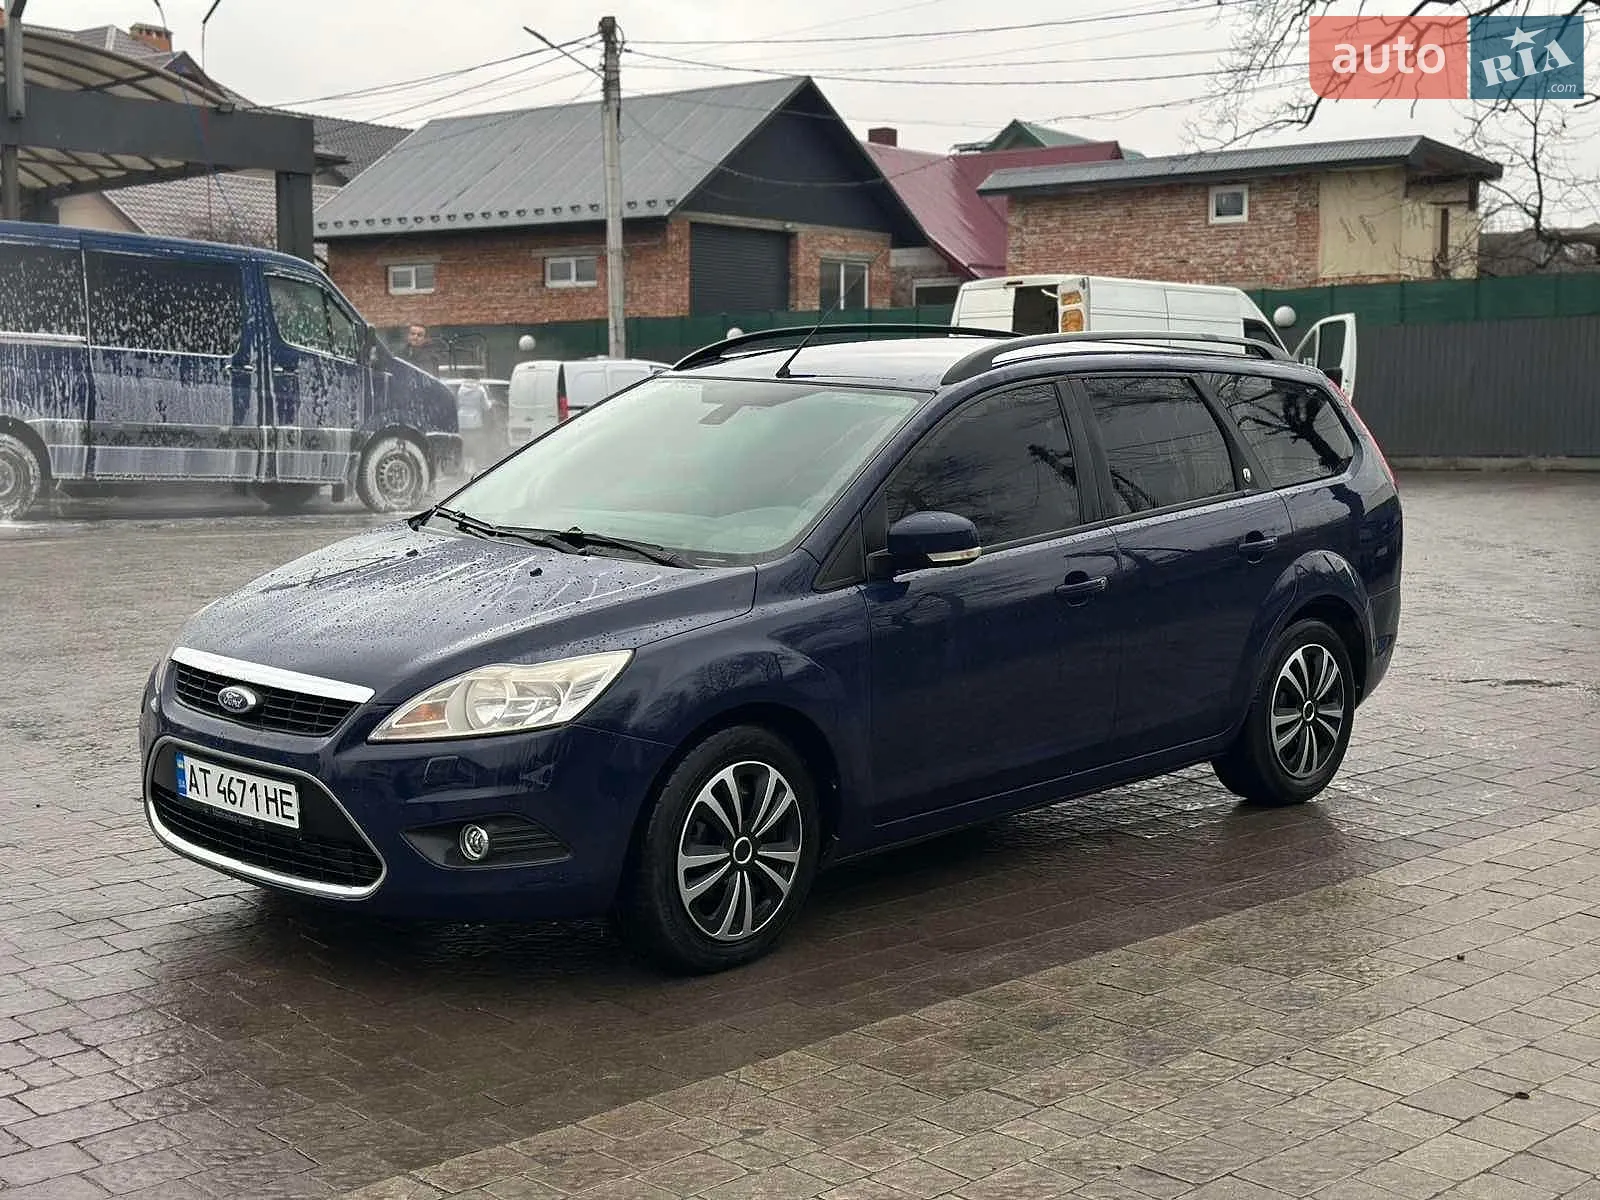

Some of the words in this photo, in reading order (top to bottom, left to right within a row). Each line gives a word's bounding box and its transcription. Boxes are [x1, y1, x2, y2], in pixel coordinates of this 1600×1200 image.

[223, 691, 243, 708] Ford
[188, 764, 211, 798] AT
[216, 773, 260, 813] 4671
[263, 785, 295, 821] HE
